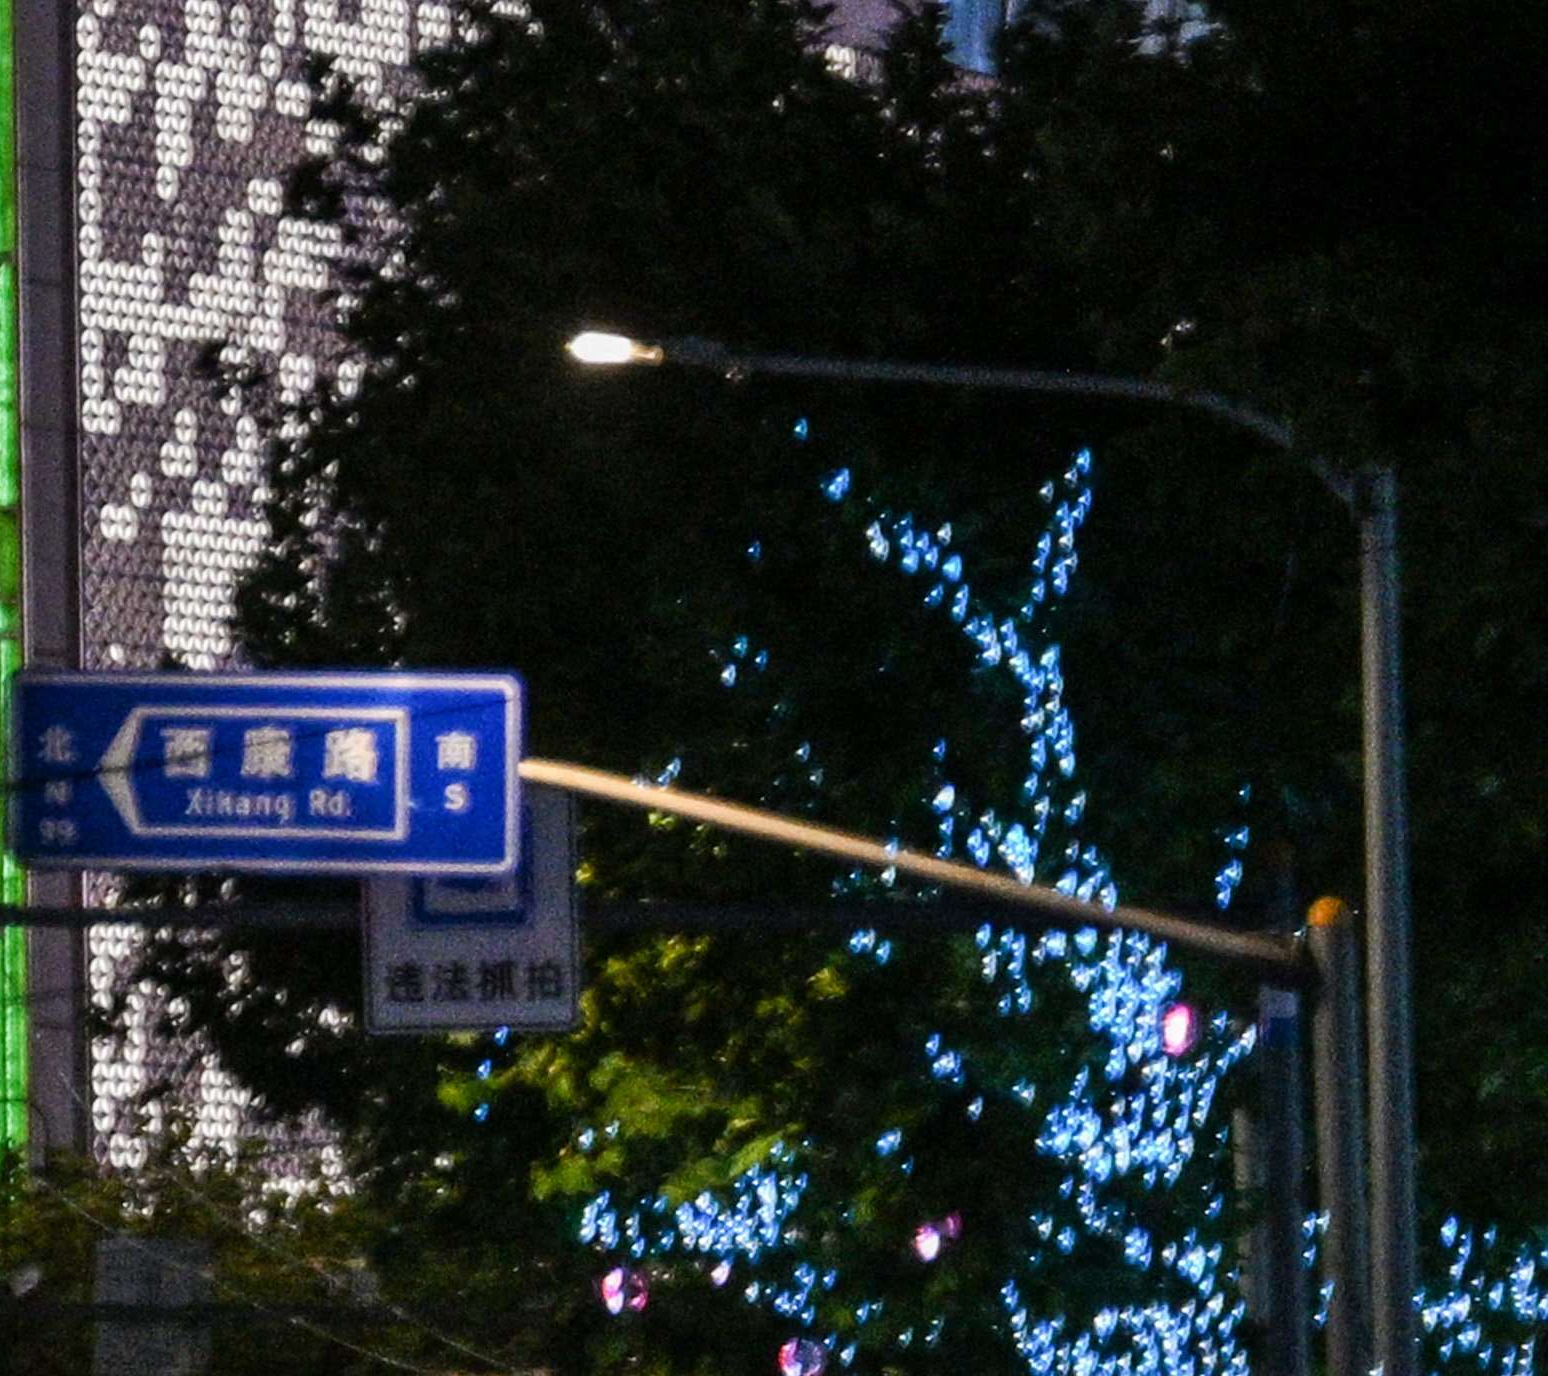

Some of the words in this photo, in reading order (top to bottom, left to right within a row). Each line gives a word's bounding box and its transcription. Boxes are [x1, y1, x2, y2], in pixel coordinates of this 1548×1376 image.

[160, 725, 379, 783] 西康路
[434, 731, 478, 772] 南
[308, 787, 353, 817] Rd.
[444, 782, 470, 812] S
[385, 959, 565, 1002] 违法抓拍
